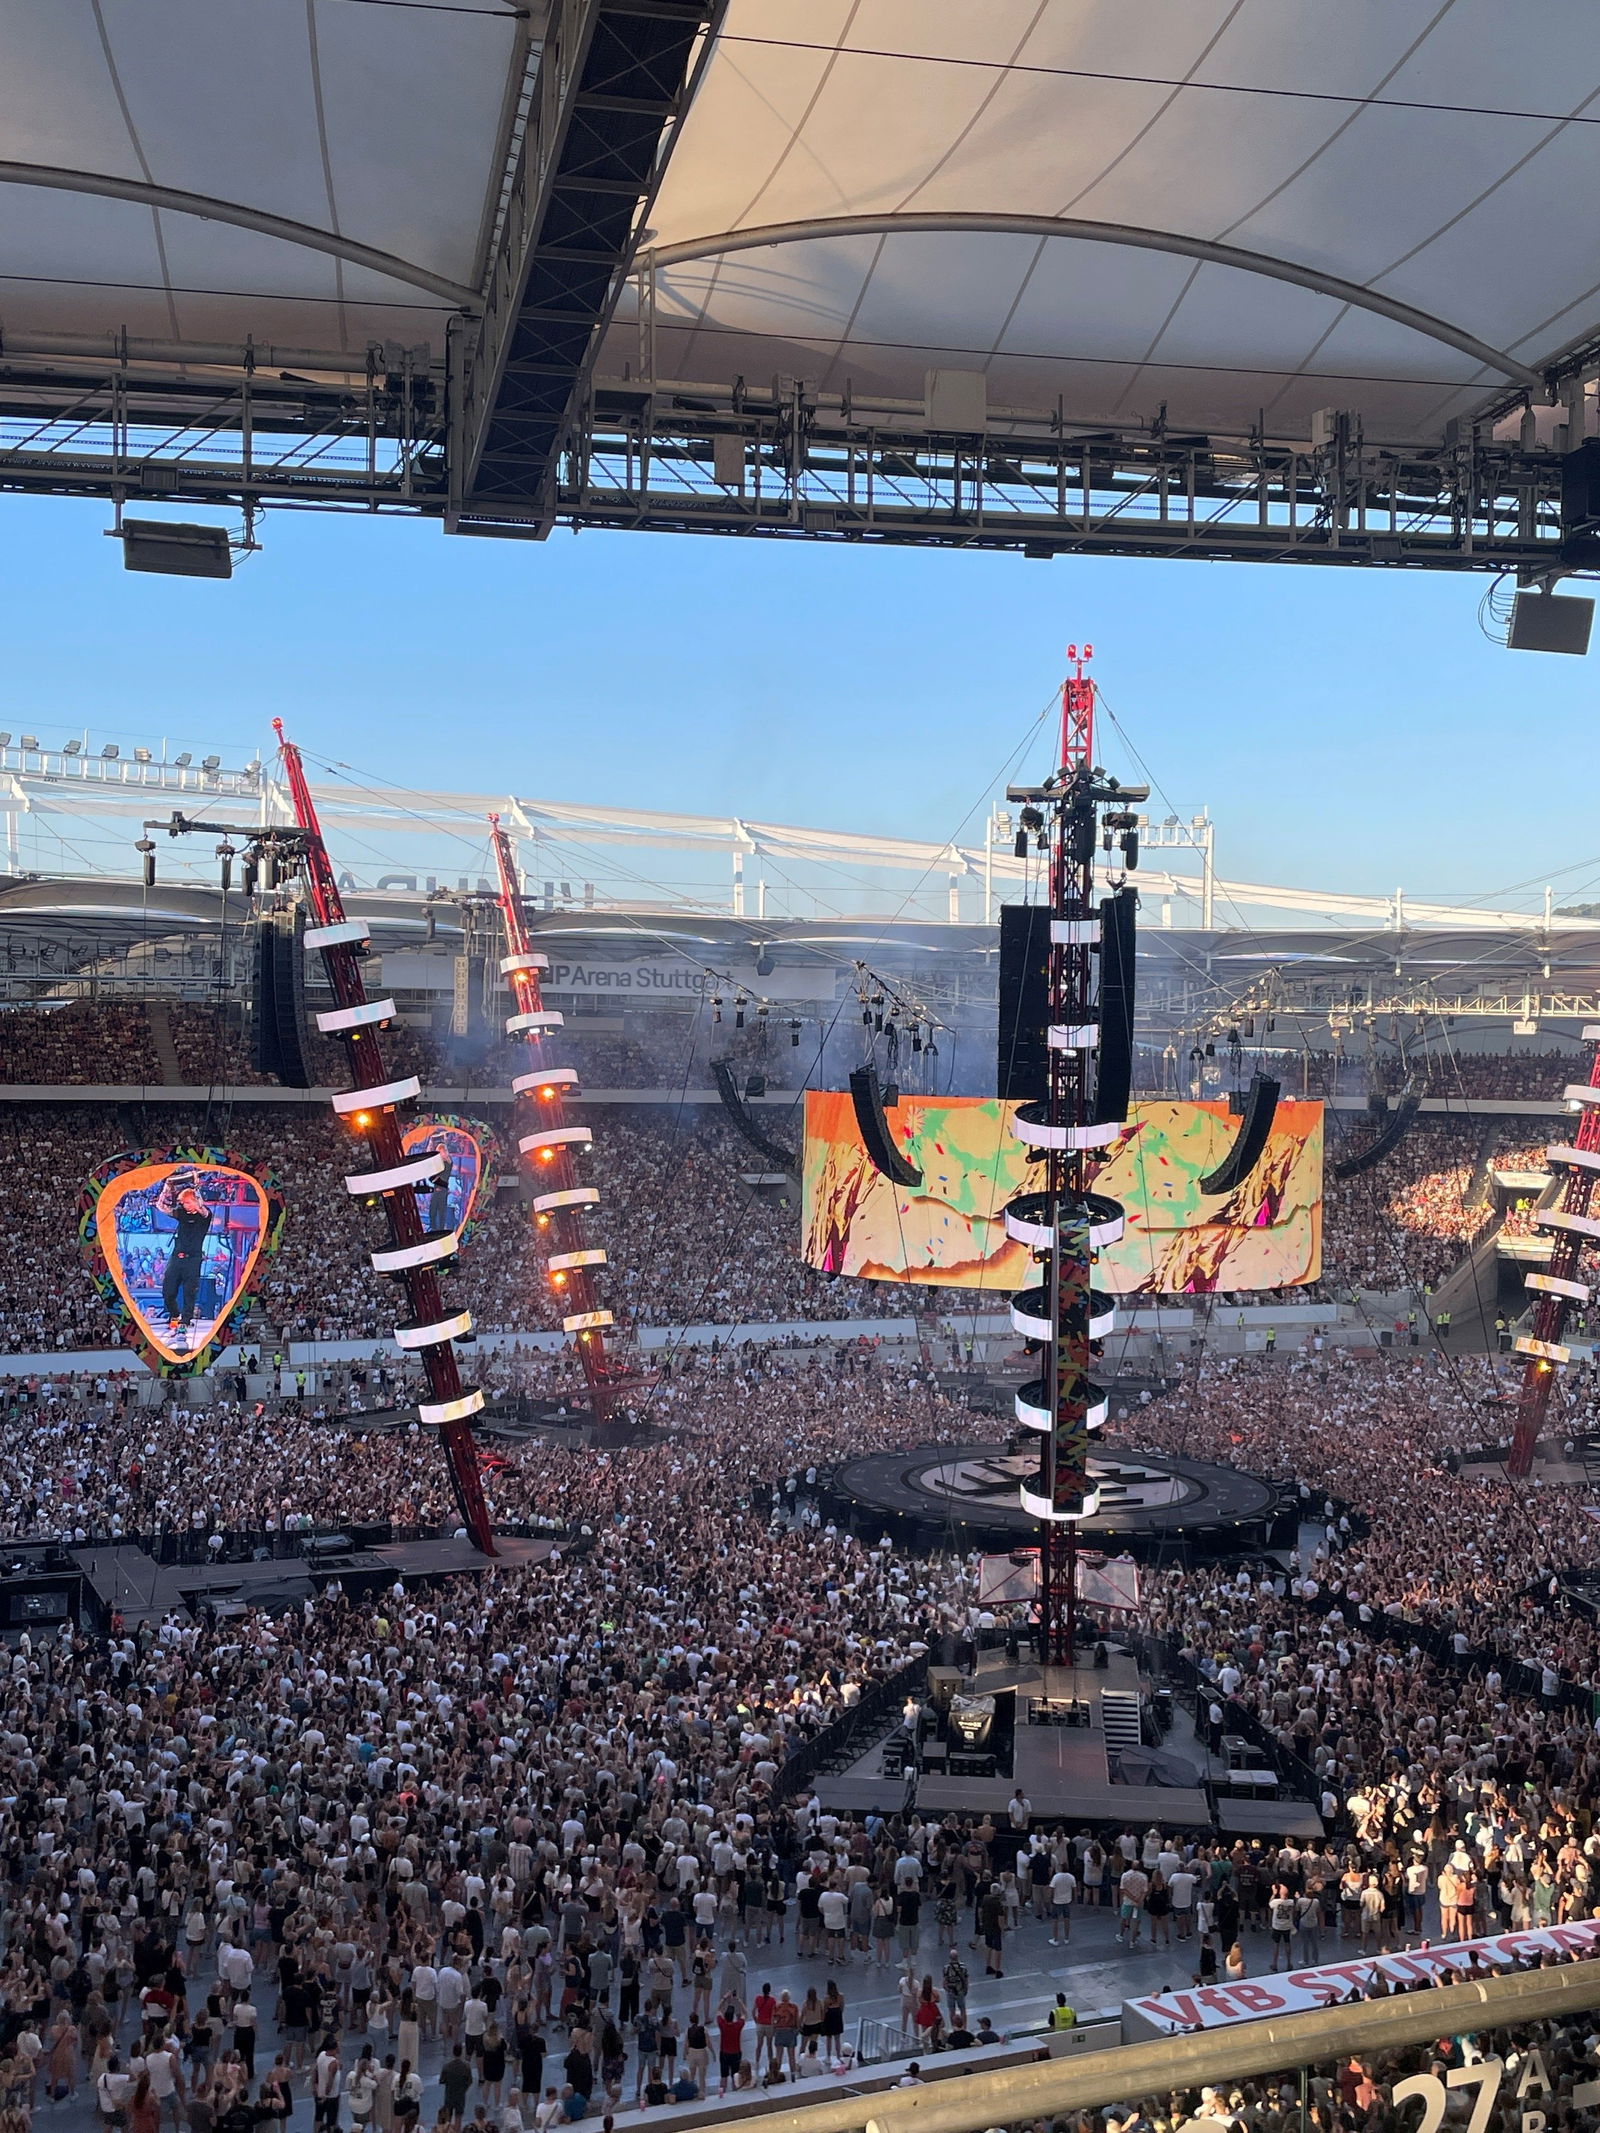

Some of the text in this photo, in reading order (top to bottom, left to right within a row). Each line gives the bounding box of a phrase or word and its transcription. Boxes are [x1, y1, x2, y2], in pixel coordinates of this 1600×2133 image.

[570, 965, 632, 987] Arena
[1136, 1922, 1600, 2024] VfB STUTTGA
